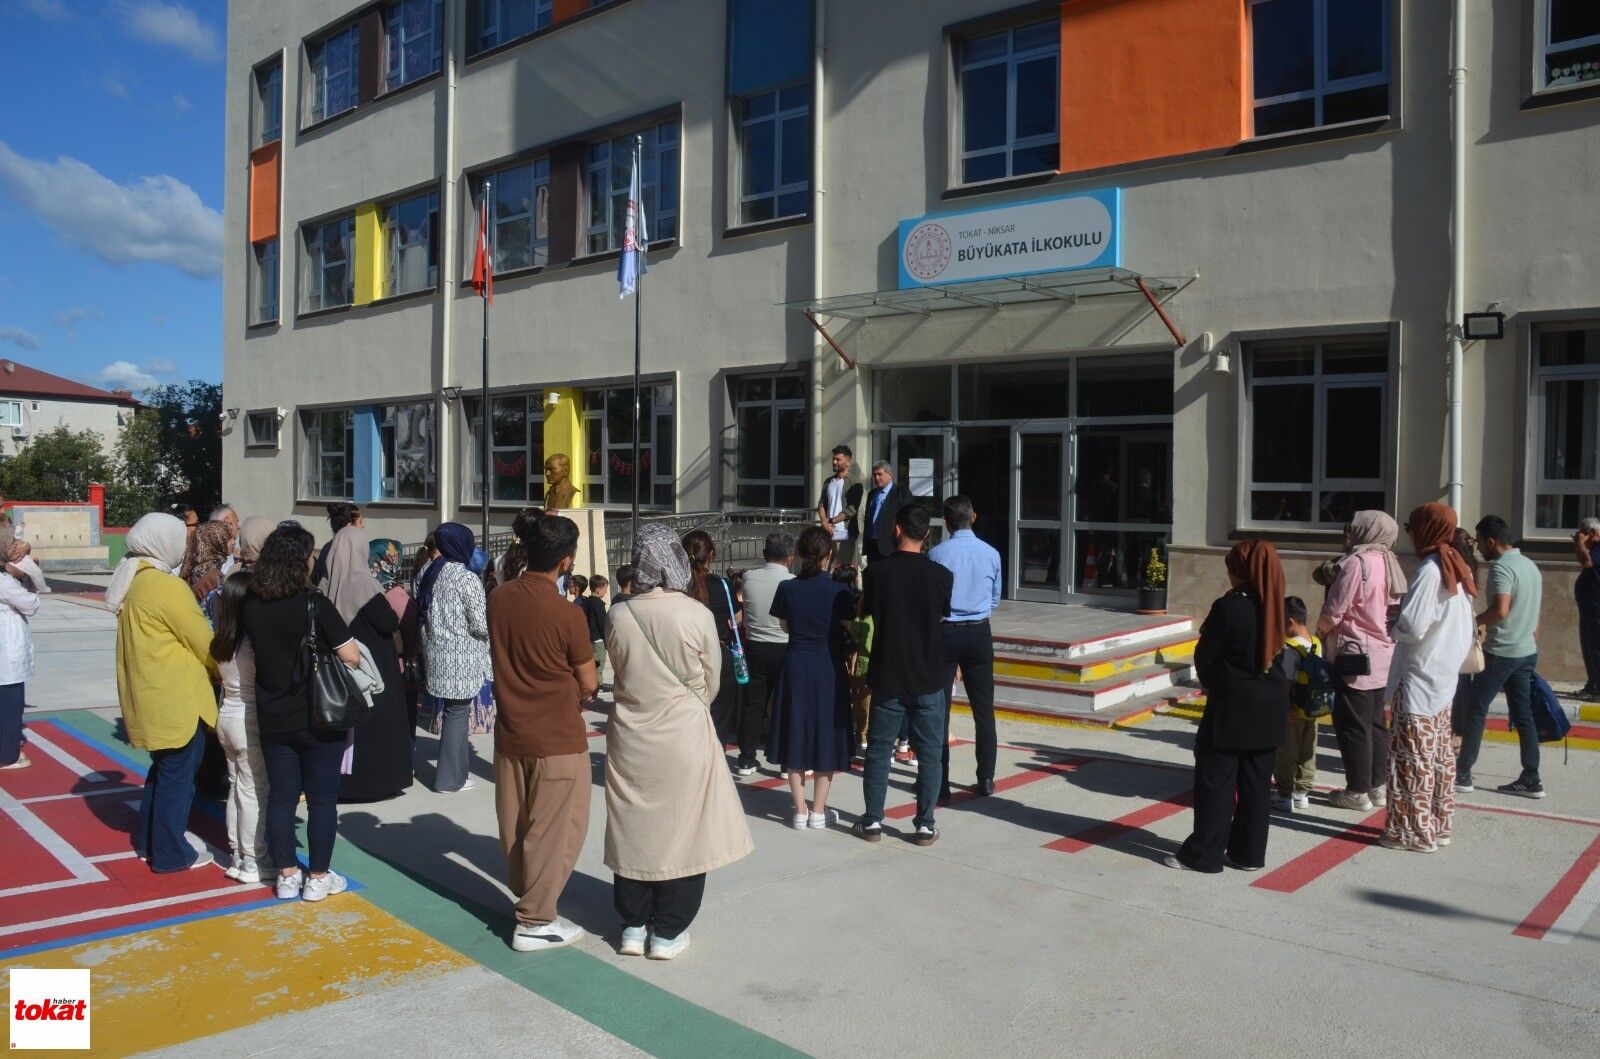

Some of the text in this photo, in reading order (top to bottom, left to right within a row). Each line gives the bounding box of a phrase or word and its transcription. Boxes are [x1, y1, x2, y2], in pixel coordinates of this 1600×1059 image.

[959, 228, 982, 240] TOKAT
[988, 224, 1016, 236] NİKSAR
[957, 241, 1028, 262] BÜYÜKATA
[1031, 231, 1103, 253] İLKOKULU
